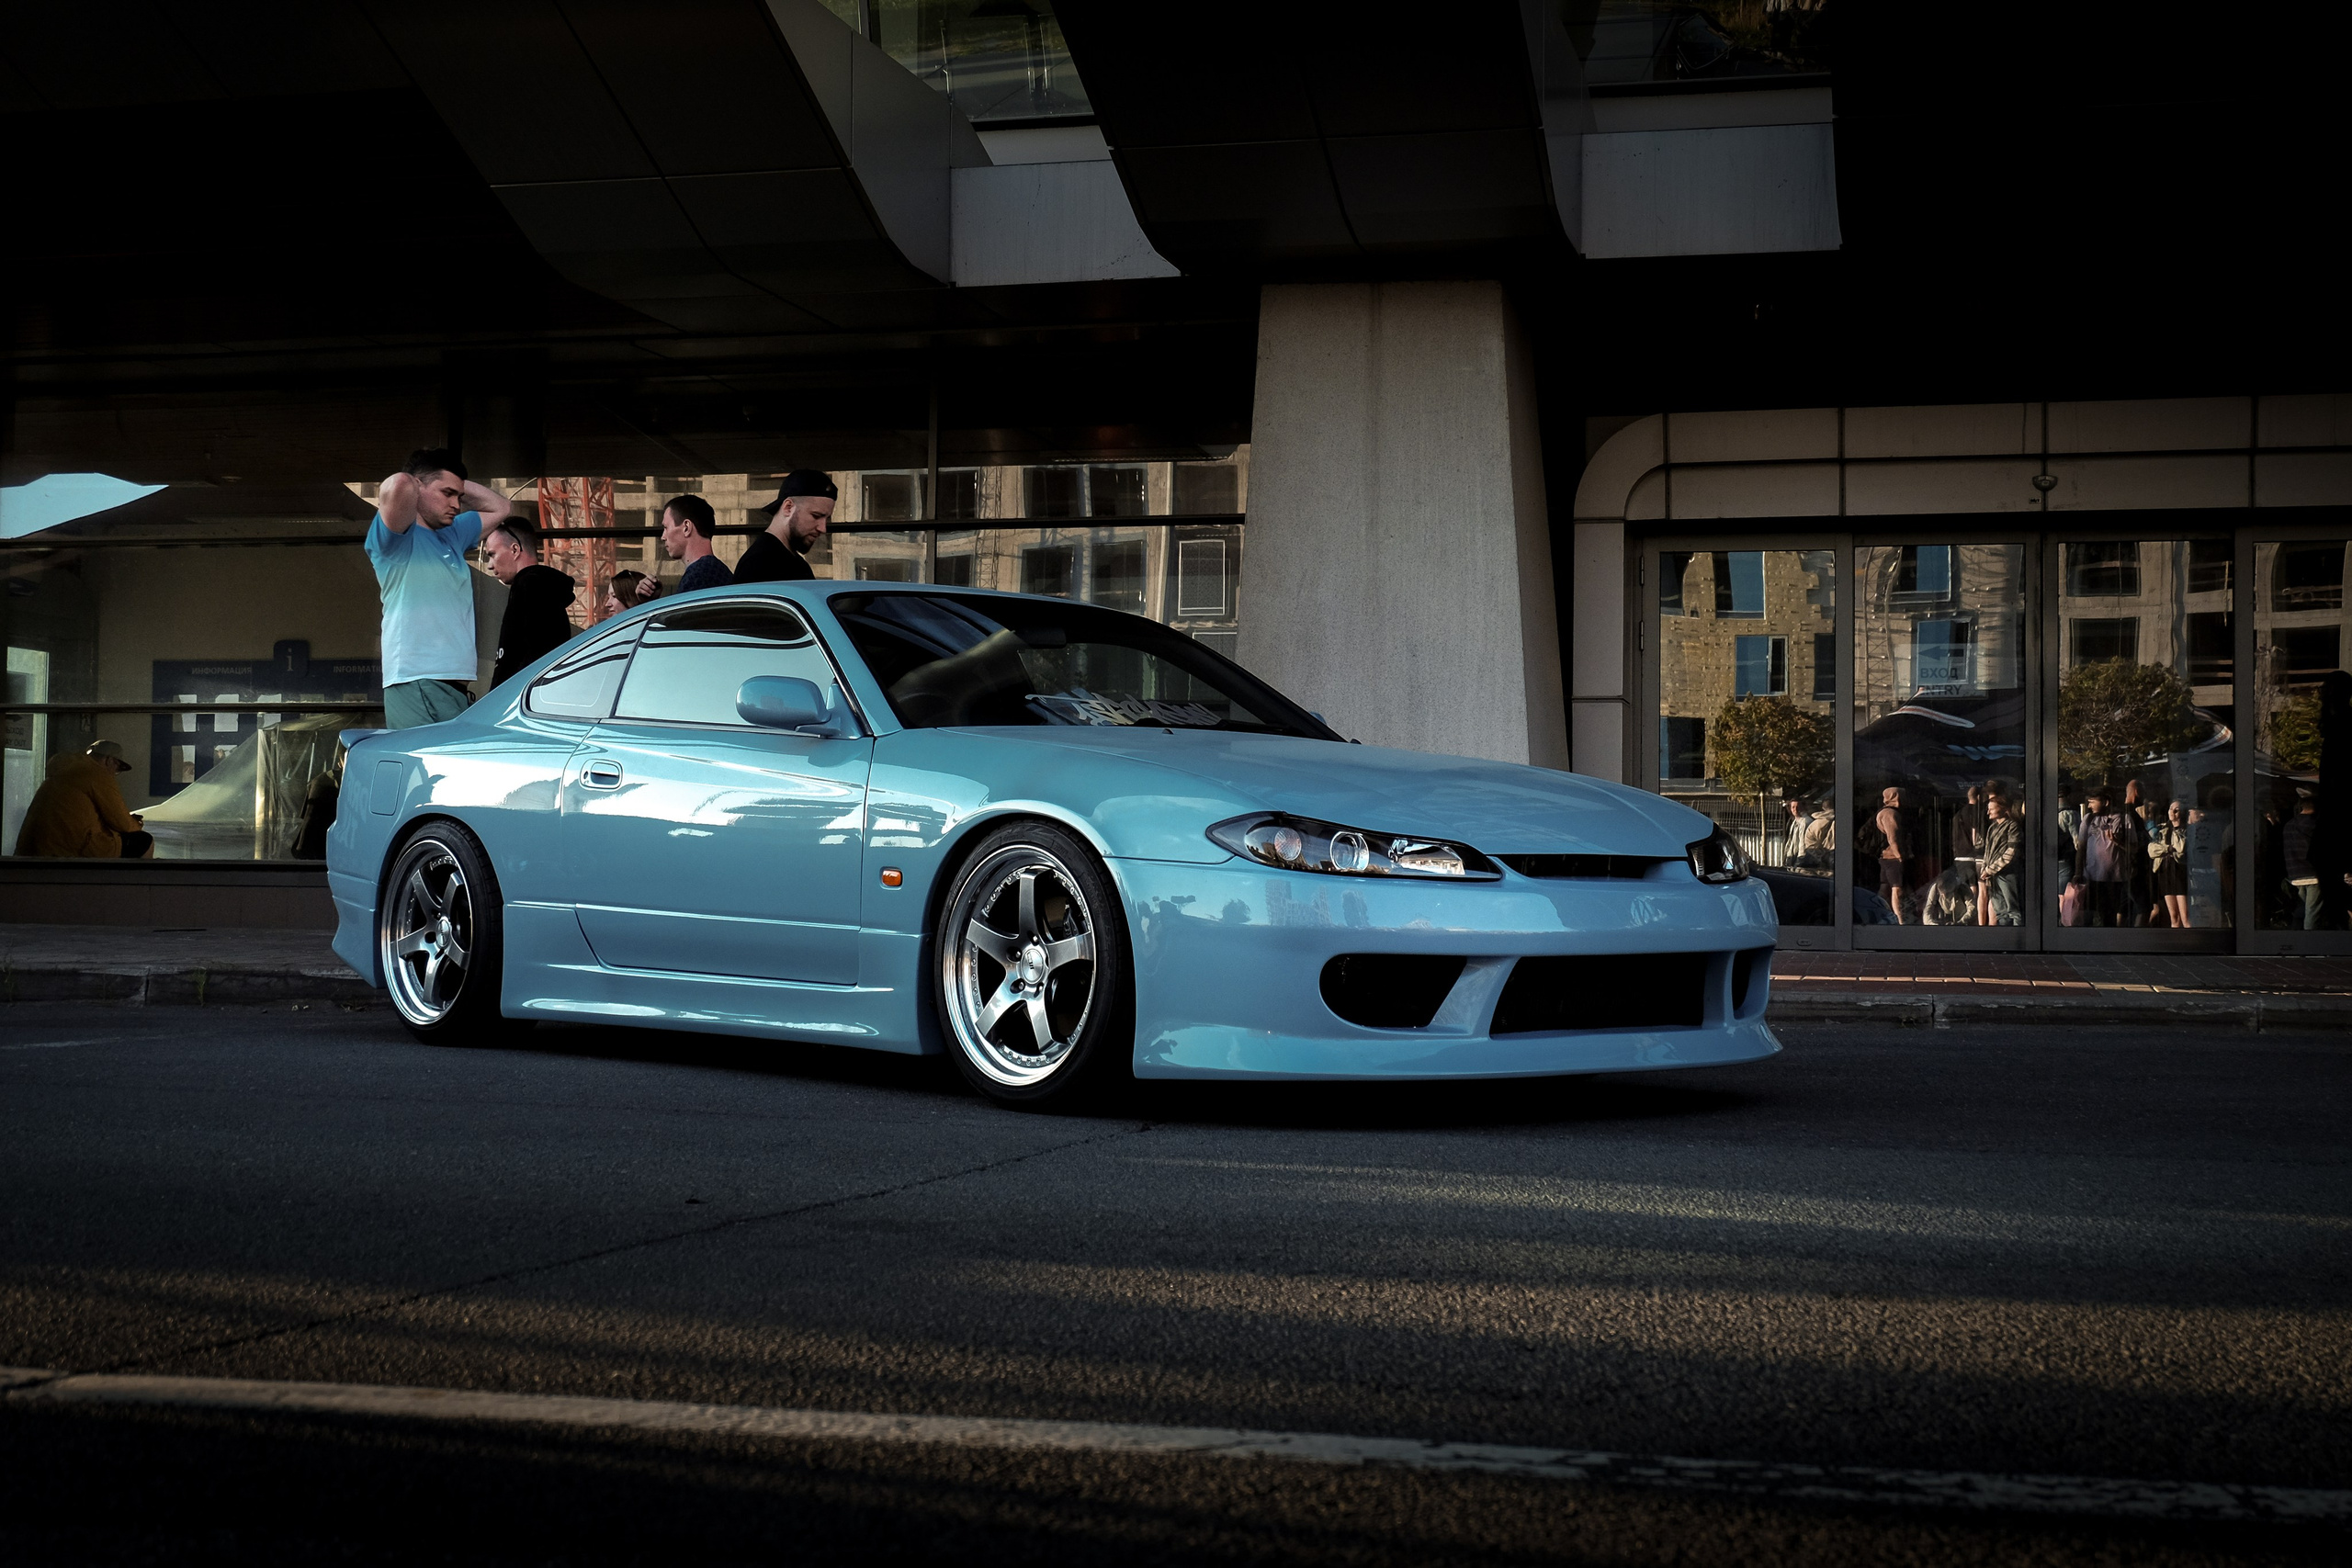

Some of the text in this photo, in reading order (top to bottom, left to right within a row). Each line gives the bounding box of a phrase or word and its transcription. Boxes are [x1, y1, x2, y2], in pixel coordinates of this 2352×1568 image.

[191, 666, 252, 675] ИНФОРМАЦИЯ
[333, 665, 382, 673] INFORMATI
[1920, 668, 1958, 680] ВХОД
